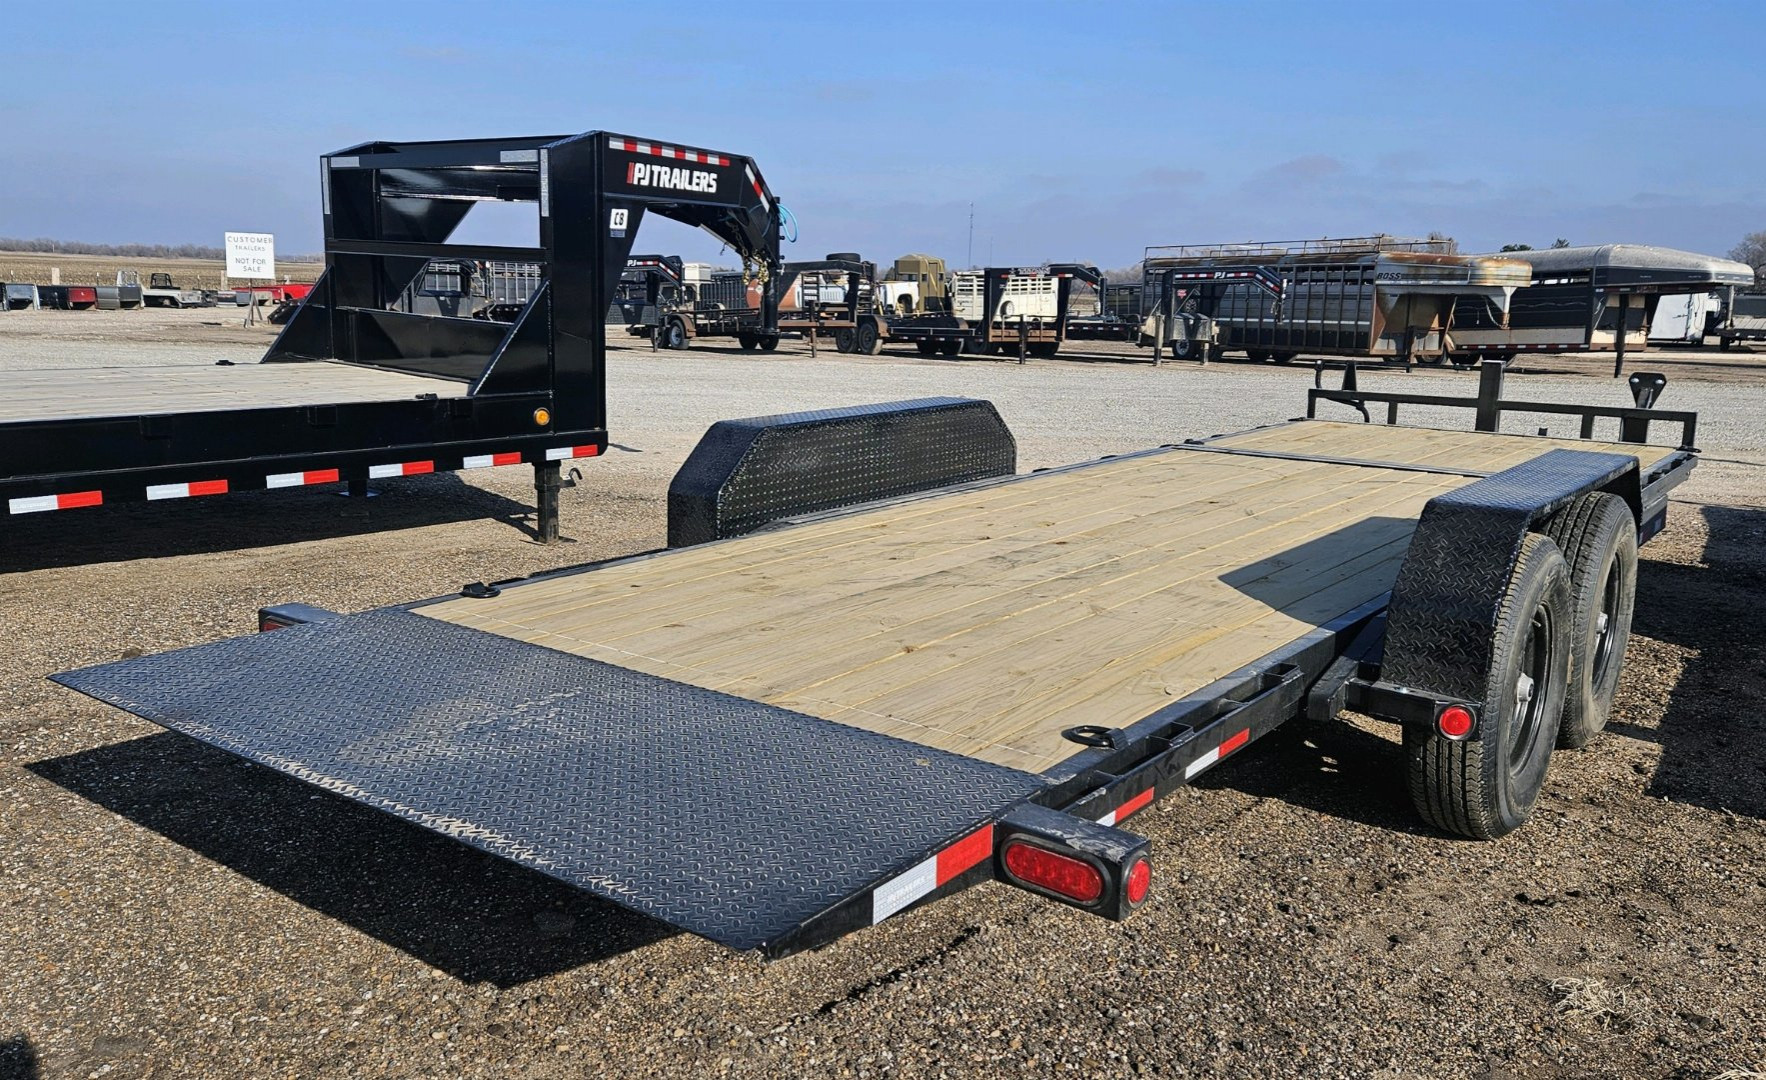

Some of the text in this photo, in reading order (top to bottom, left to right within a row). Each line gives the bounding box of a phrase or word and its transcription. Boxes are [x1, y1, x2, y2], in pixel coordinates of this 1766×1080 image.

[633, 163, 717, 193] PJ TRAILERS
[614, 212, 624, 226] C8
[227, 236, 272, 244] CUSTOMER
[1377, 272, 1401, 280] BOSS
